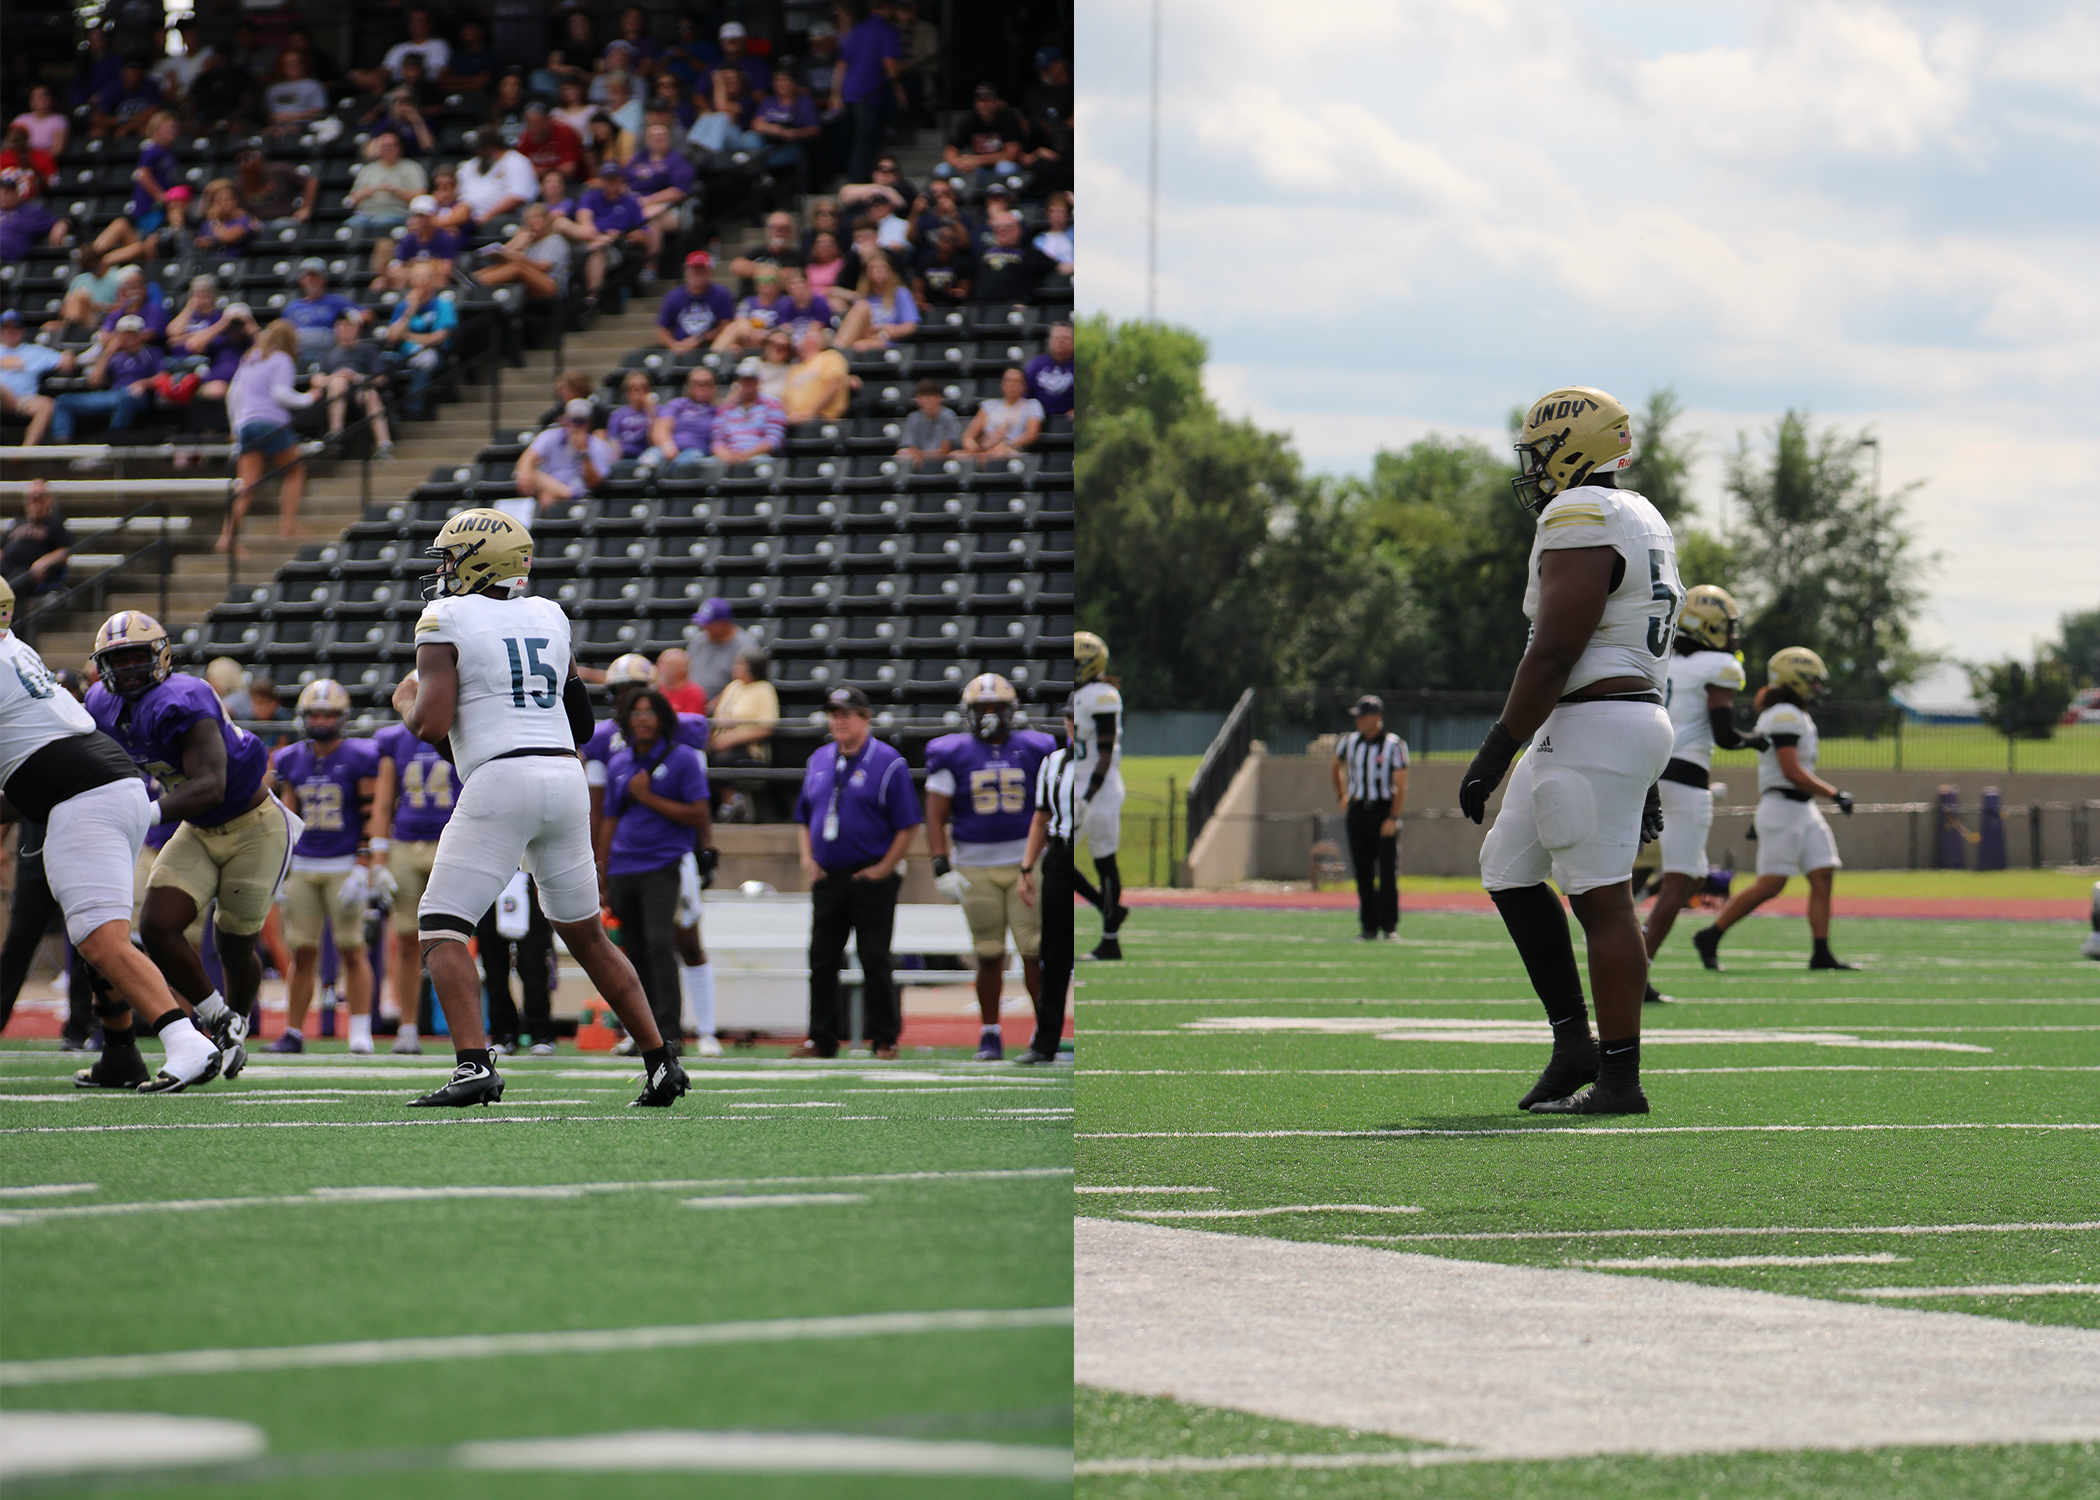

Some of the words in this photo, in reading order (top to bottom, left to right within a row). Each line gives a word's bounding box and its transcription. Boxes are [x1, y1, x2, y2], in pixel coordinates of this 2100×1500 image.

[1533, 400, 1586, 427] INDY
[454, 517, 503, 534] INDY
[501, 637, 558, 709] 15
[297, 783, 345, 831] 52
[402, 760, 453, 808] 44
[970, 768, 1026, 815] 55
[652, 1062, 668, 1091] NIKE
